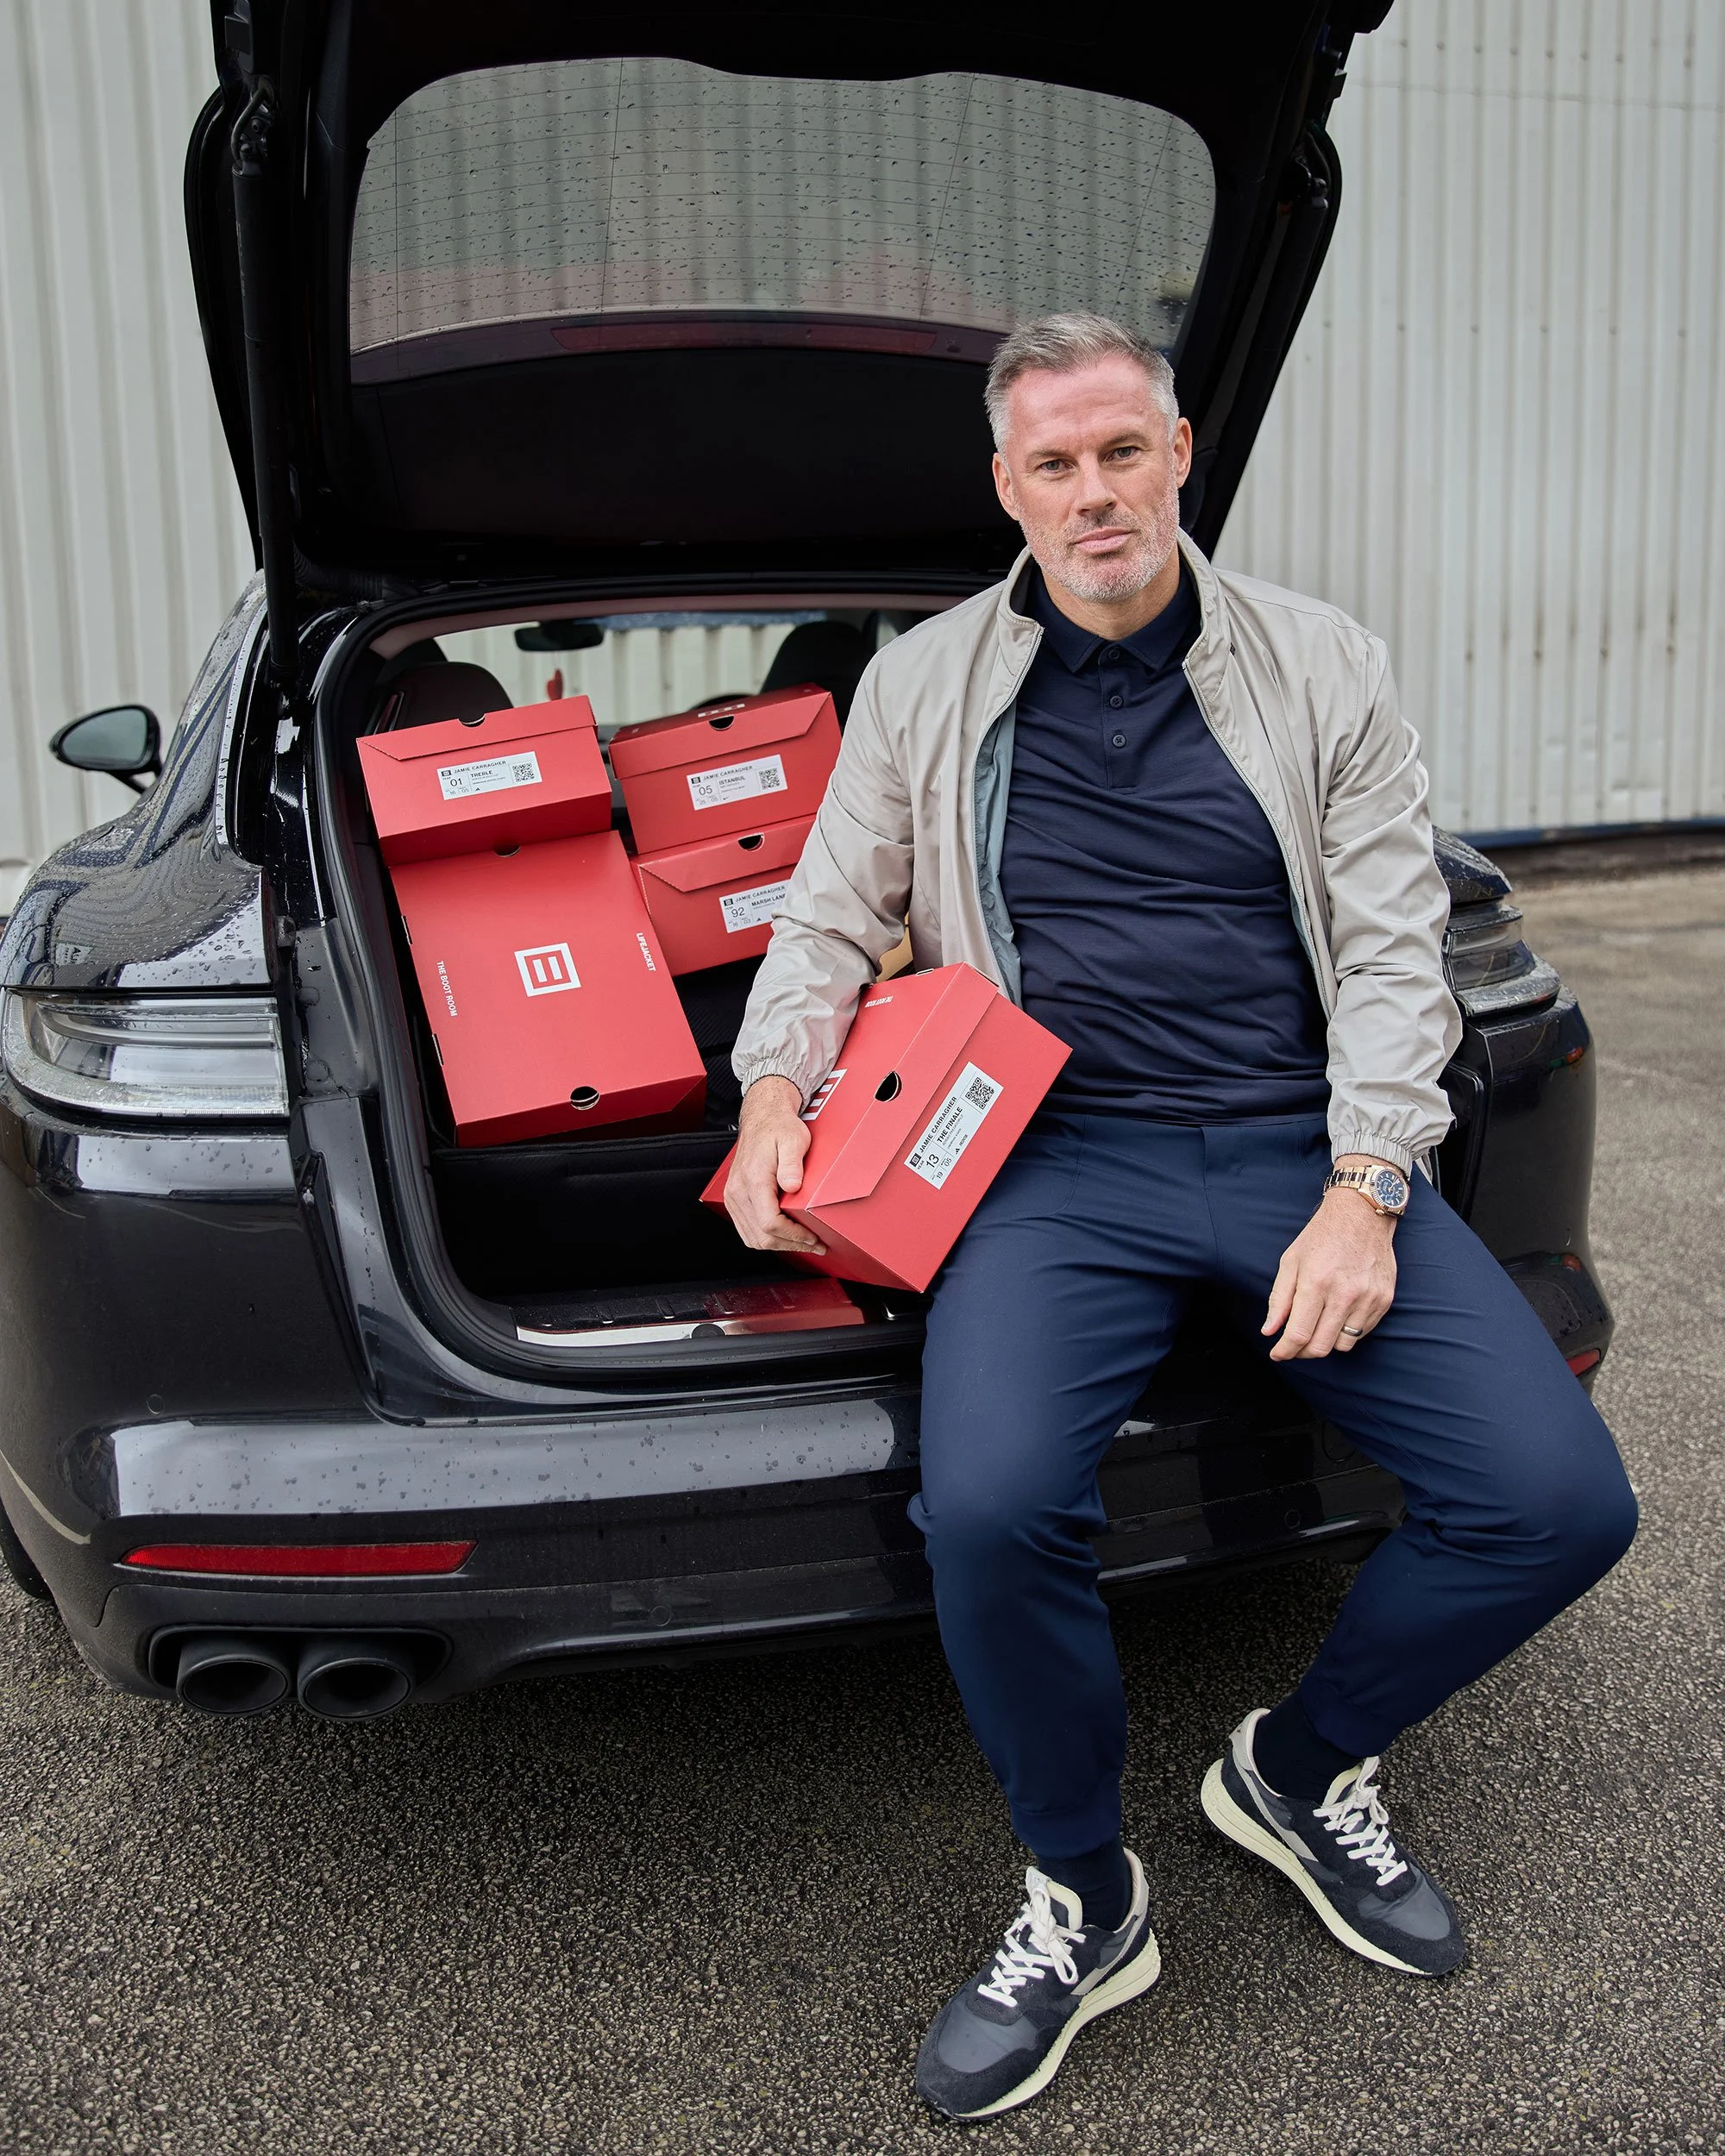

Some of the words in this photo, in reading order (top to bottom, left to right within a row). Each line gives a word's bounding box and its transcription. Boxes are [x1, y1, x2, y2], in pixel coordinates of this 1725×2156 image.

[472, 761, 506, 770] CARRAGHER
[719, 766, 752, 776] CARRAGHER
[449, 778, 462, 787] 01
[719, 776, 745, 785] ISTANBUL
[699, 785, 712, 795] 05
[752, 886, 785, 897] CARRAGHER
[731, 907, 745, 918] 92
[637, 932, 656, 971] LIFEJACKET
[436, 961, 446, 975] THE
[440, 975, 452, 993] BOOT
[445, 995, 458, 1016] ROOM
[919, 1133, 933, 1152] JAMIE
[932, 1096, 957, 1133] CARRAGHER
[937, 1129, 949, 1144] THE
[945, 1106, 963, 1130] FINALE
[926, 1154, 938, 1168] 13
[944, 1158, 952, 1167] 05
[936, 1171, 944, 1180] 19
